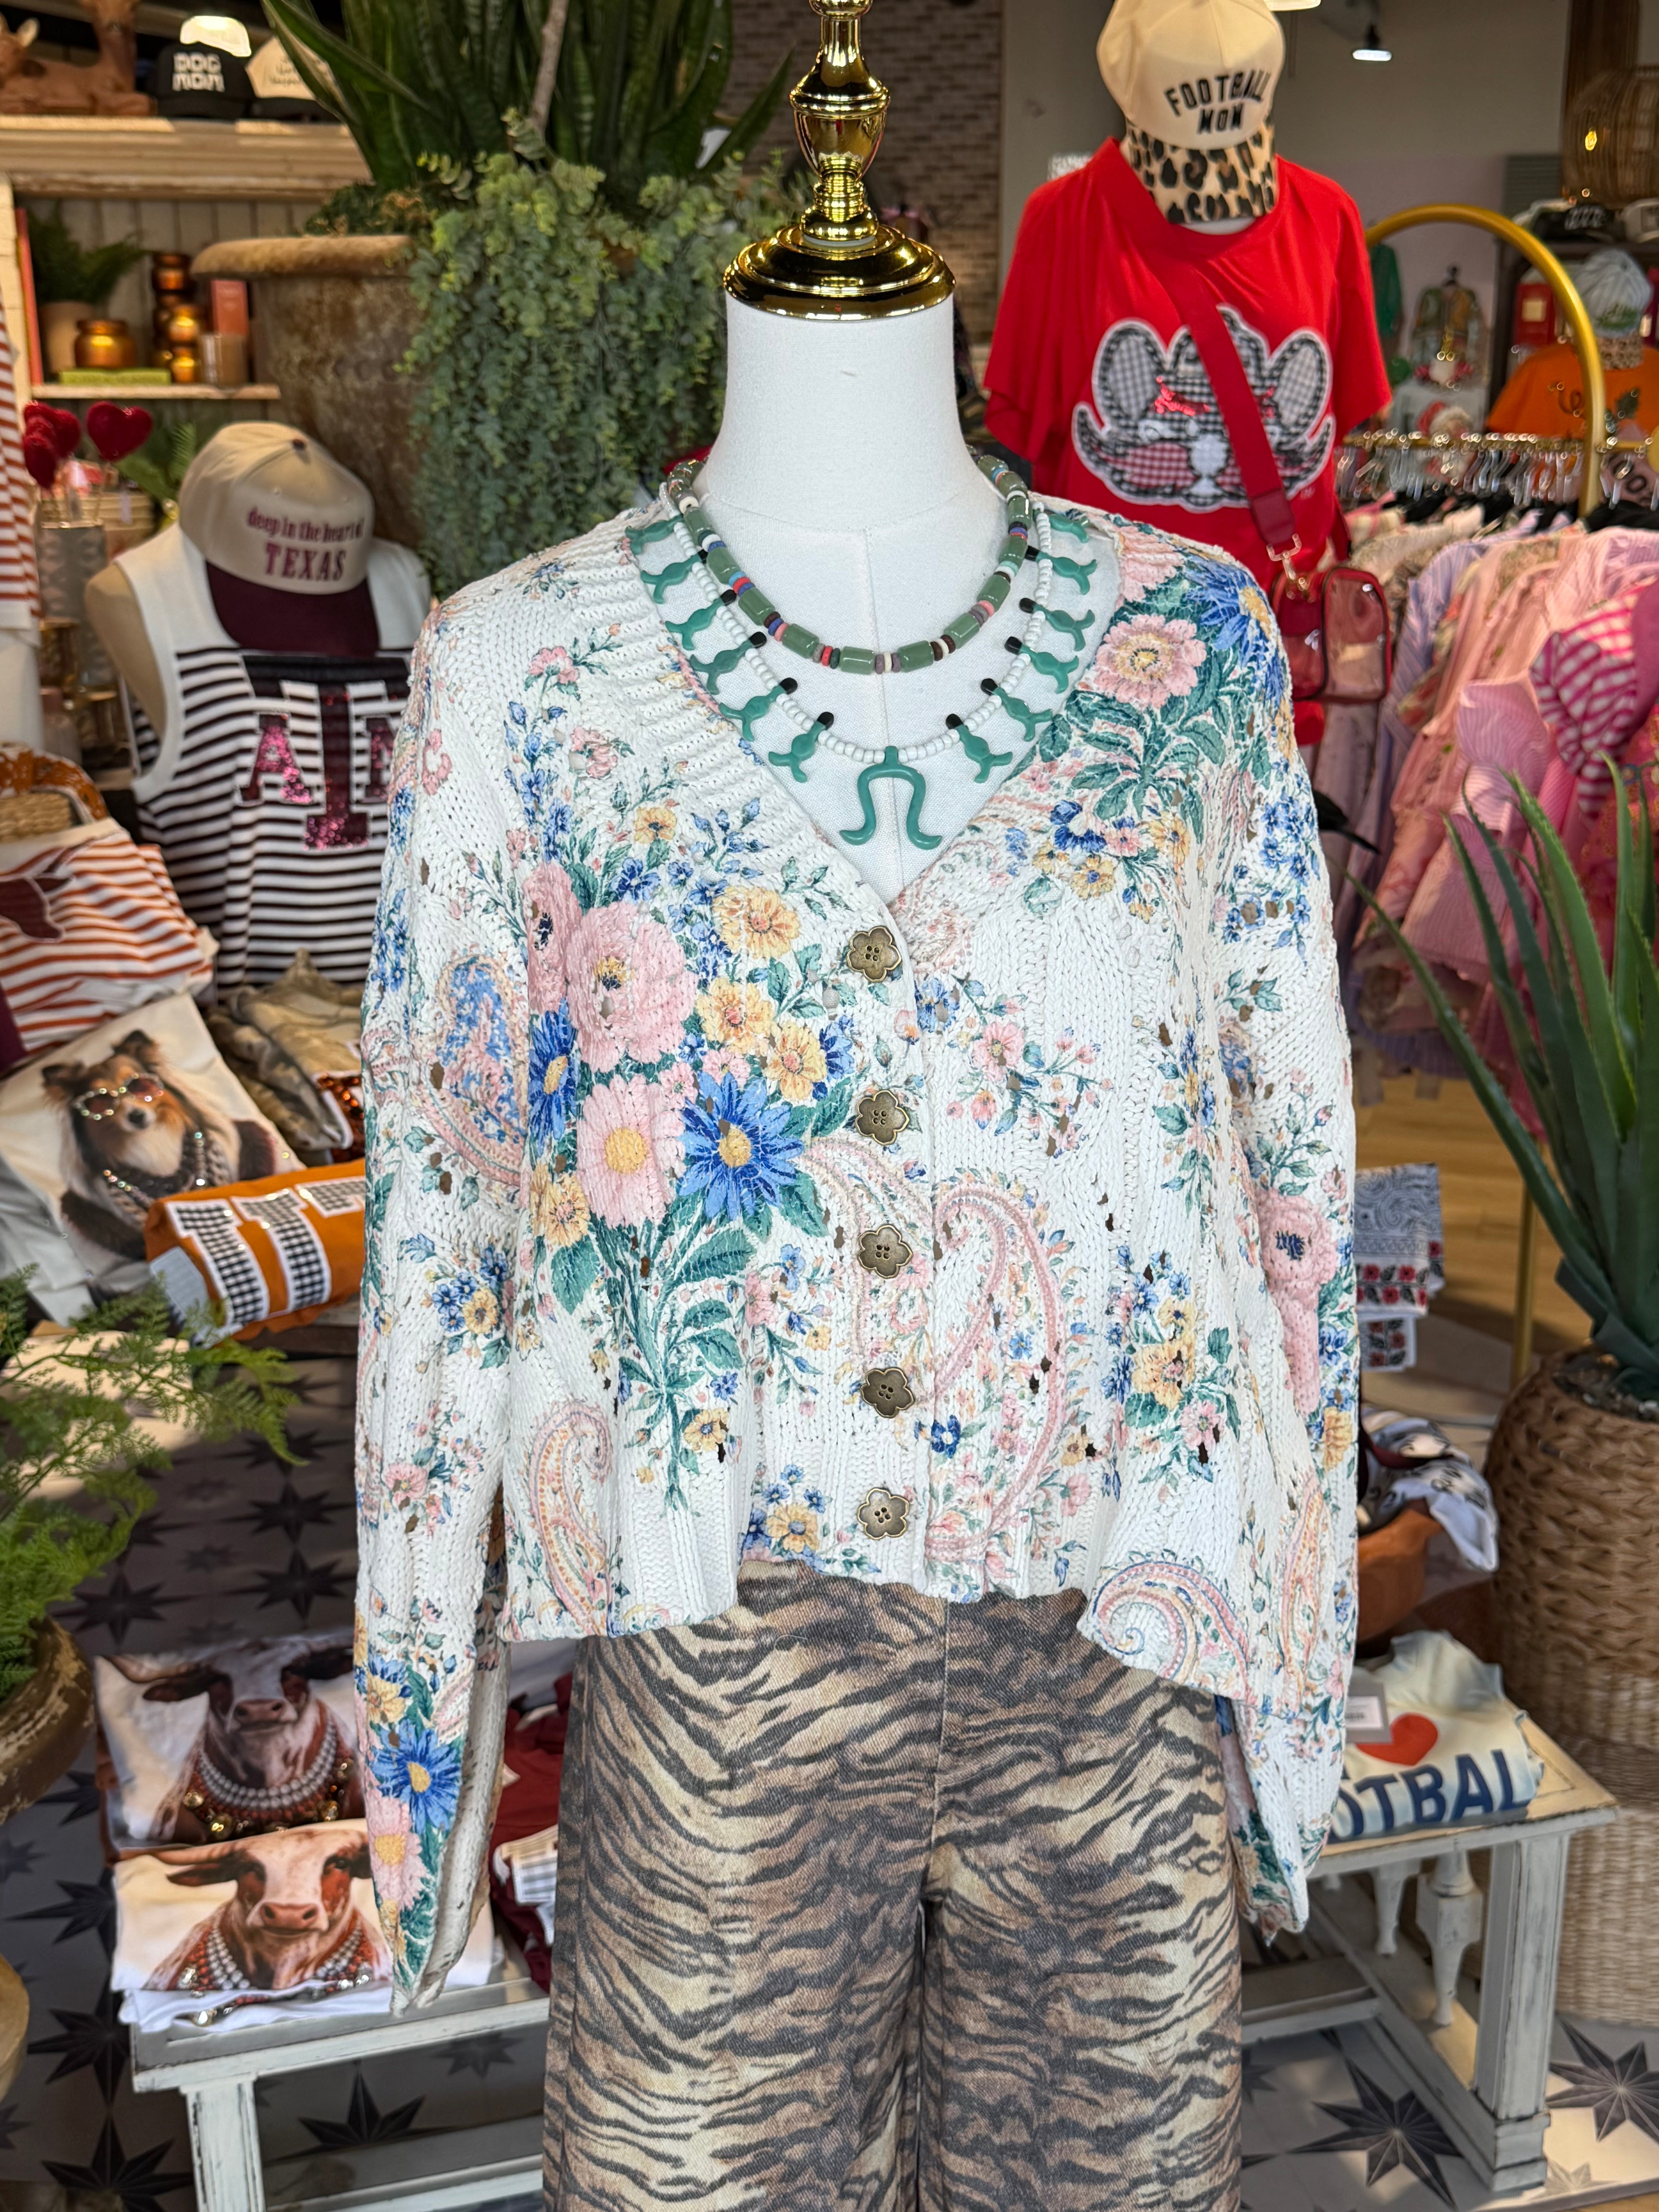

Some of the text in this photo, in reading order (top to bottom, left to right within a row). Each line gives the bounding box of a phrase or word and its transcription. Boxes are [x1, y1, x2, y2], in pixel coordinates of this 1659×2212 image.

[173, 52, 222, 73] DOG
[172, 73, 225, 92] MOM
[1164, 69, 1272, 117] FOOTBALL
[1197, 102, 1244, 134] MOM
[248, 506, 280, 538] deep
[282, 515, 296, 539] in
[299, 520, 322, 541] the
[264, 541, 347, 581] TEXAS
